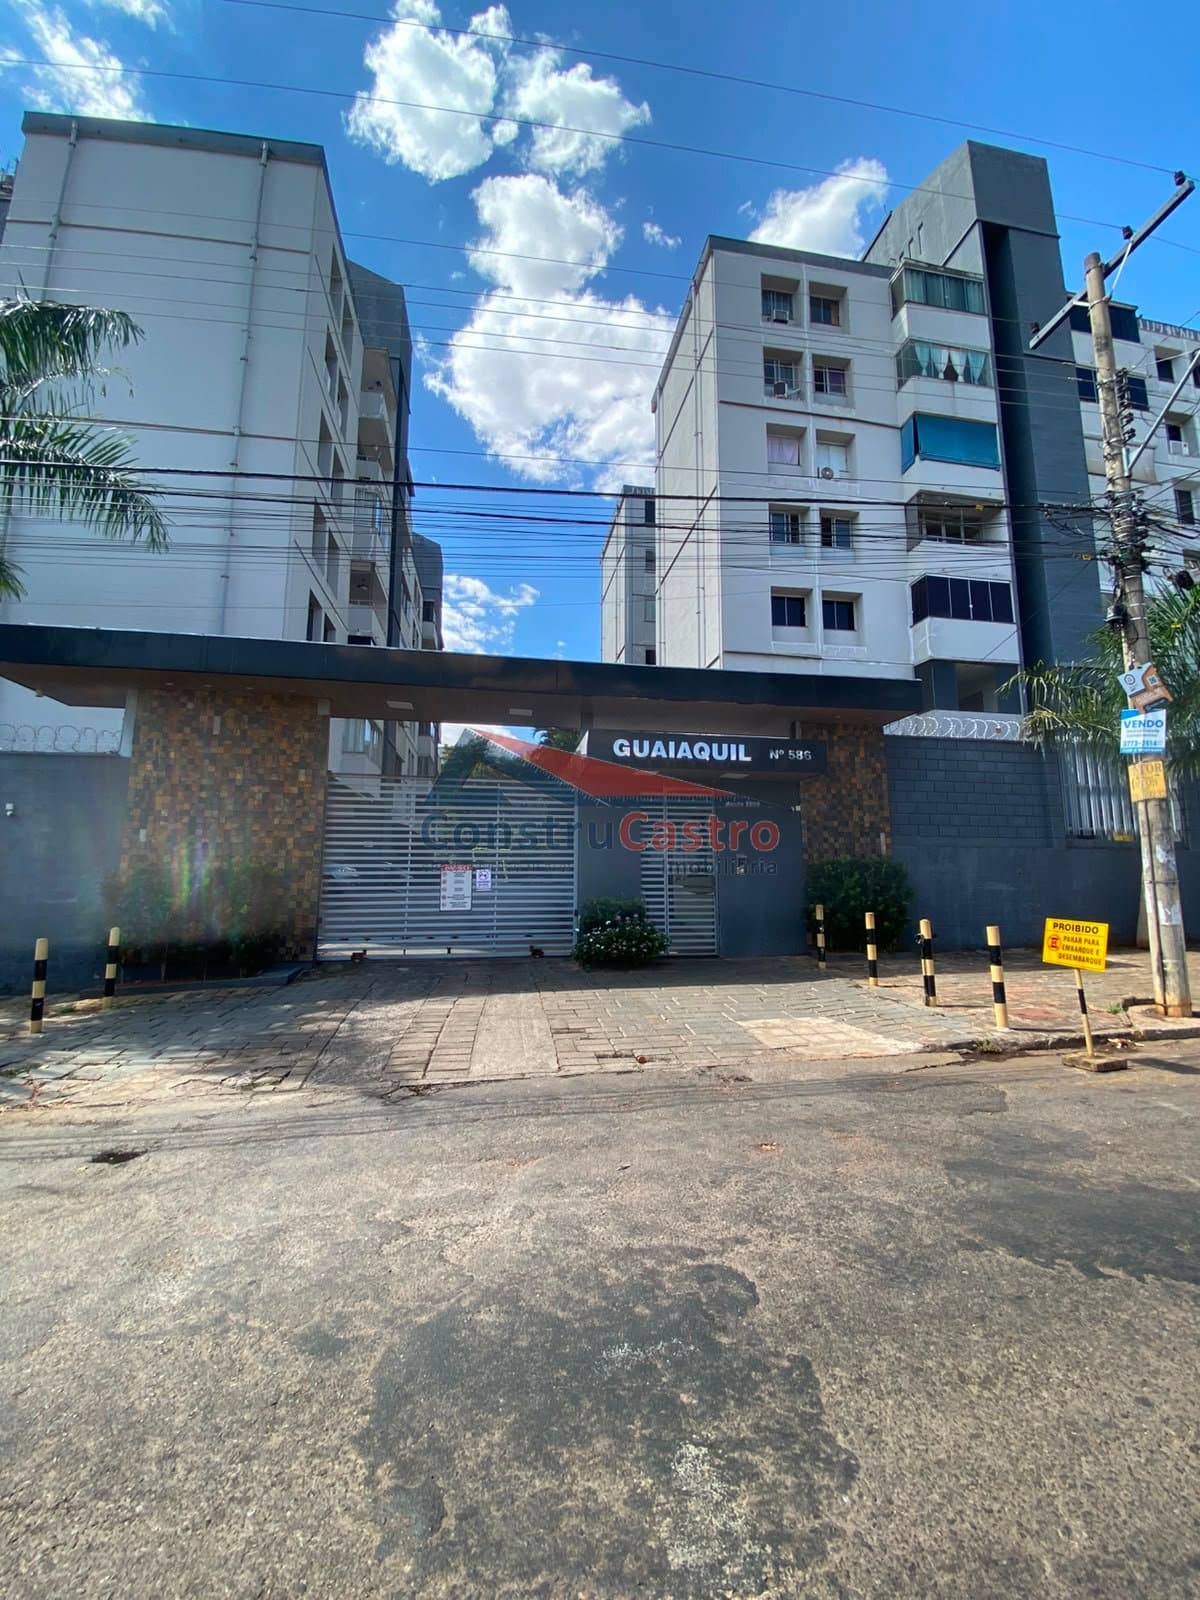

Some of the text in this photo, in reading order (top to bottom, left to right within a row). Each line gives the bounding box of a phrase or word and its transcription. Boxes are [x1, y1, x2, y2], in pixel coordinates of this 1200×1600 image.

[1123, 719, 1164, 729] VENDO
[612, 738, 753, 762] GUAIAQUIL
[788, 749, 812, 761] 586
[1053, 922, 1099, 935] PROIBIDO
[1063, 935, 1100, 946] PARAR PARA
